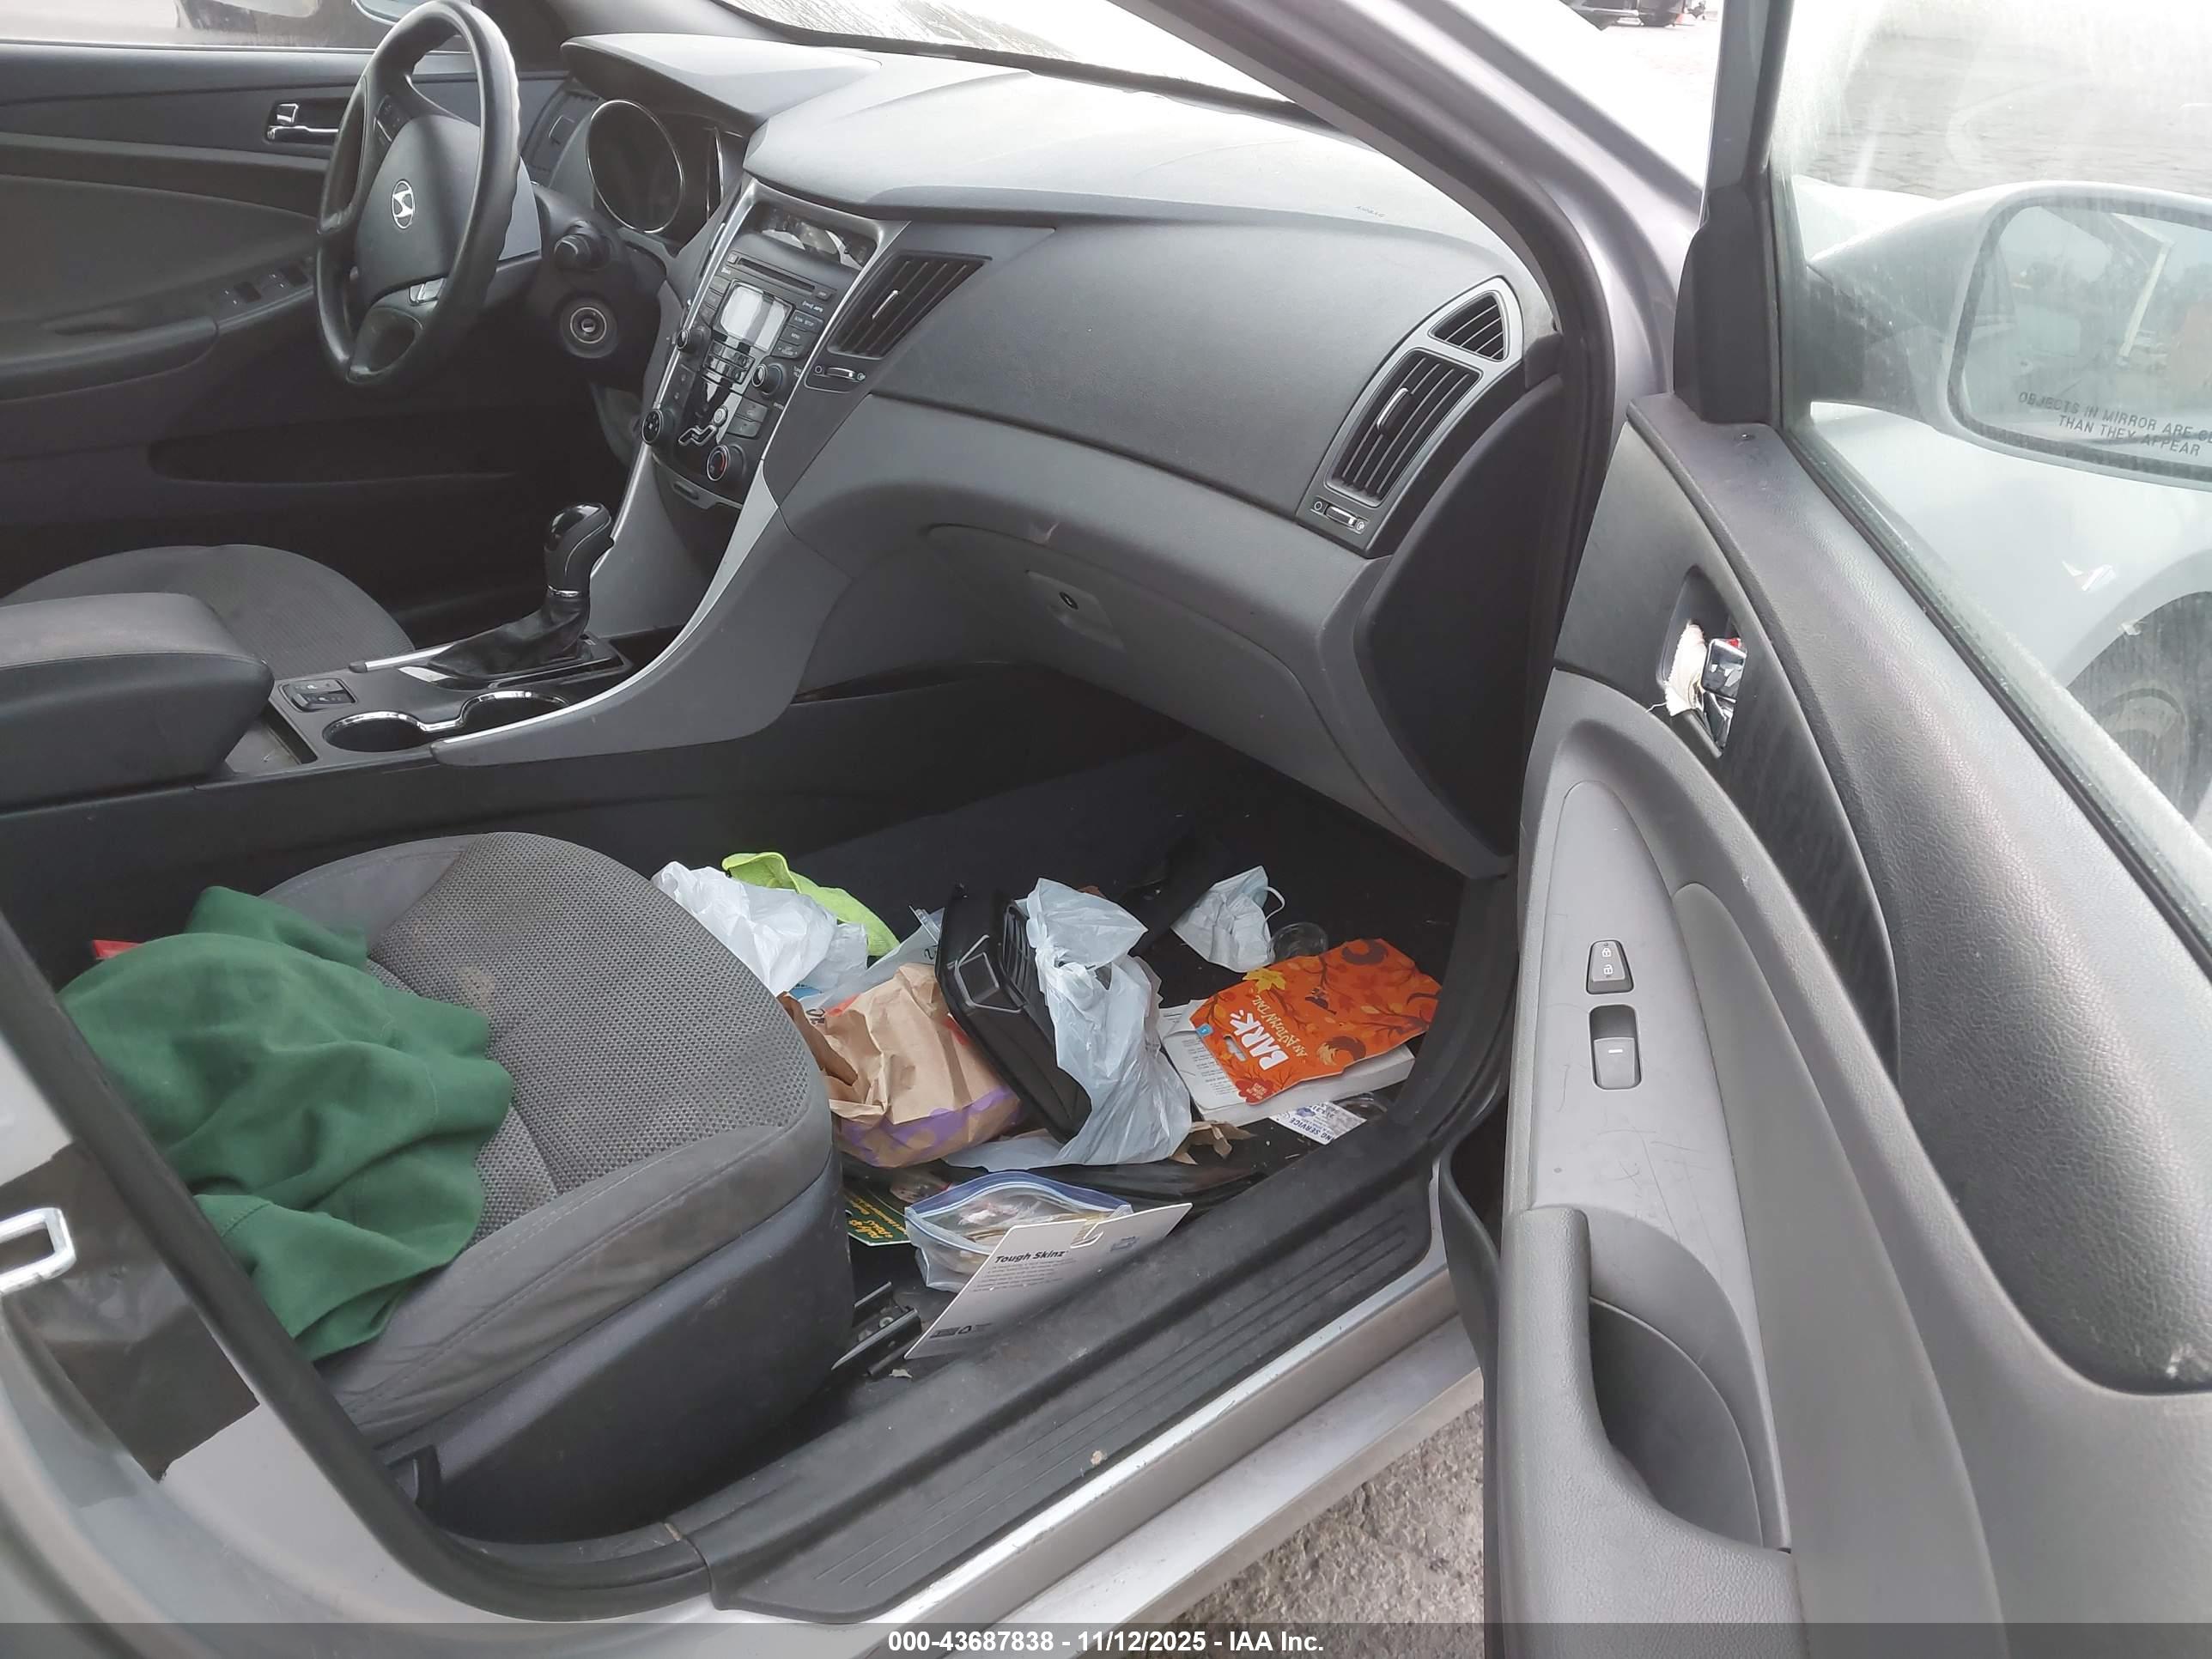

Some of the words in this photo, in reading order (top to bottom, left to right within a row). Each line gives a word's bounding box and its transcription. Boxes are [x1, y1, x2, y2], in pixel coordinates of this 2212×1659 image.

[2019, 391, 2081, 414] OBJECTS
[2084, 404, 2100, 418] IN
[2102, 410, 2157, 431] MIRROR
[2162, 422, 2193, 438] ARE
[2058, 415, 2095, 434] THAN
[2100, 423, 2137, 441] THEY
[2140, 434, 2201, 457] APPEAR
[1252, 994, 1271, 1014] TAIL
[1229, 1012, 1290, 1071] BARK
[1261, 1013, 1301, 1048] AUTUMN
[1291, 1044, 1308, 1058] AN
[1289, 1117, 1321, 1135] SERVICE
[994, 1251, 1031, 1263] Tough
